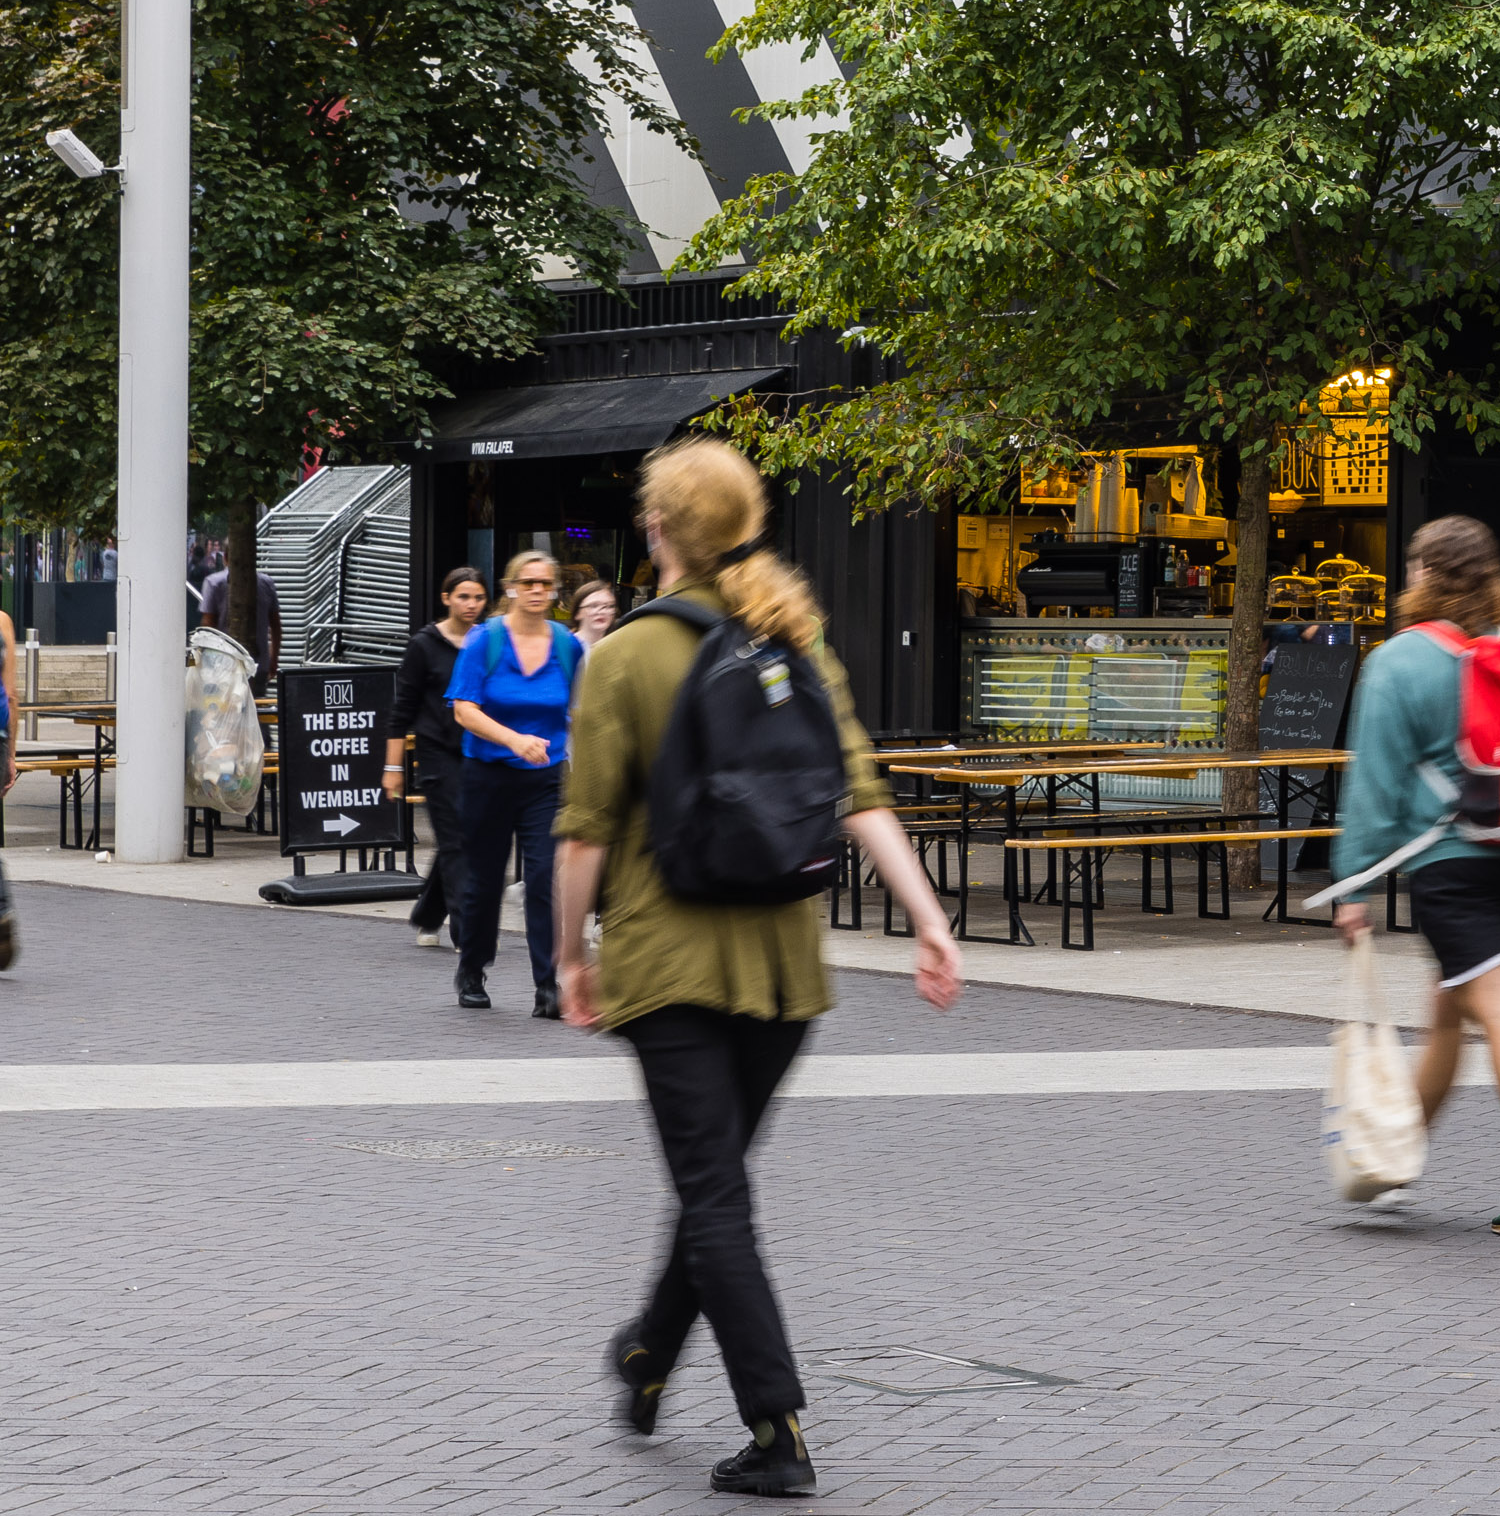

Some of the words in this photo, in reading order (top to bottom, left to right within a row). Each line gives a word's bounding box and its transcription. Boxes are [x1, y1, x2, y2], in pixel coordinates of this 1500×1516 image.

[472, 442, 486, 455] VIVA
[486, 441, 514, 454] FALAFEL
[1121, 553, 1139, 572] ICE
[324, 684, 353, 705] BOKI
[302, 713, 334, 731] THE
[337, 711, 376, 730] BEST
[310, 737, 370, 757] COFFEE
[331, 764, 350, 782] IN
[301, 788, 382, 809] WEMBLEY
